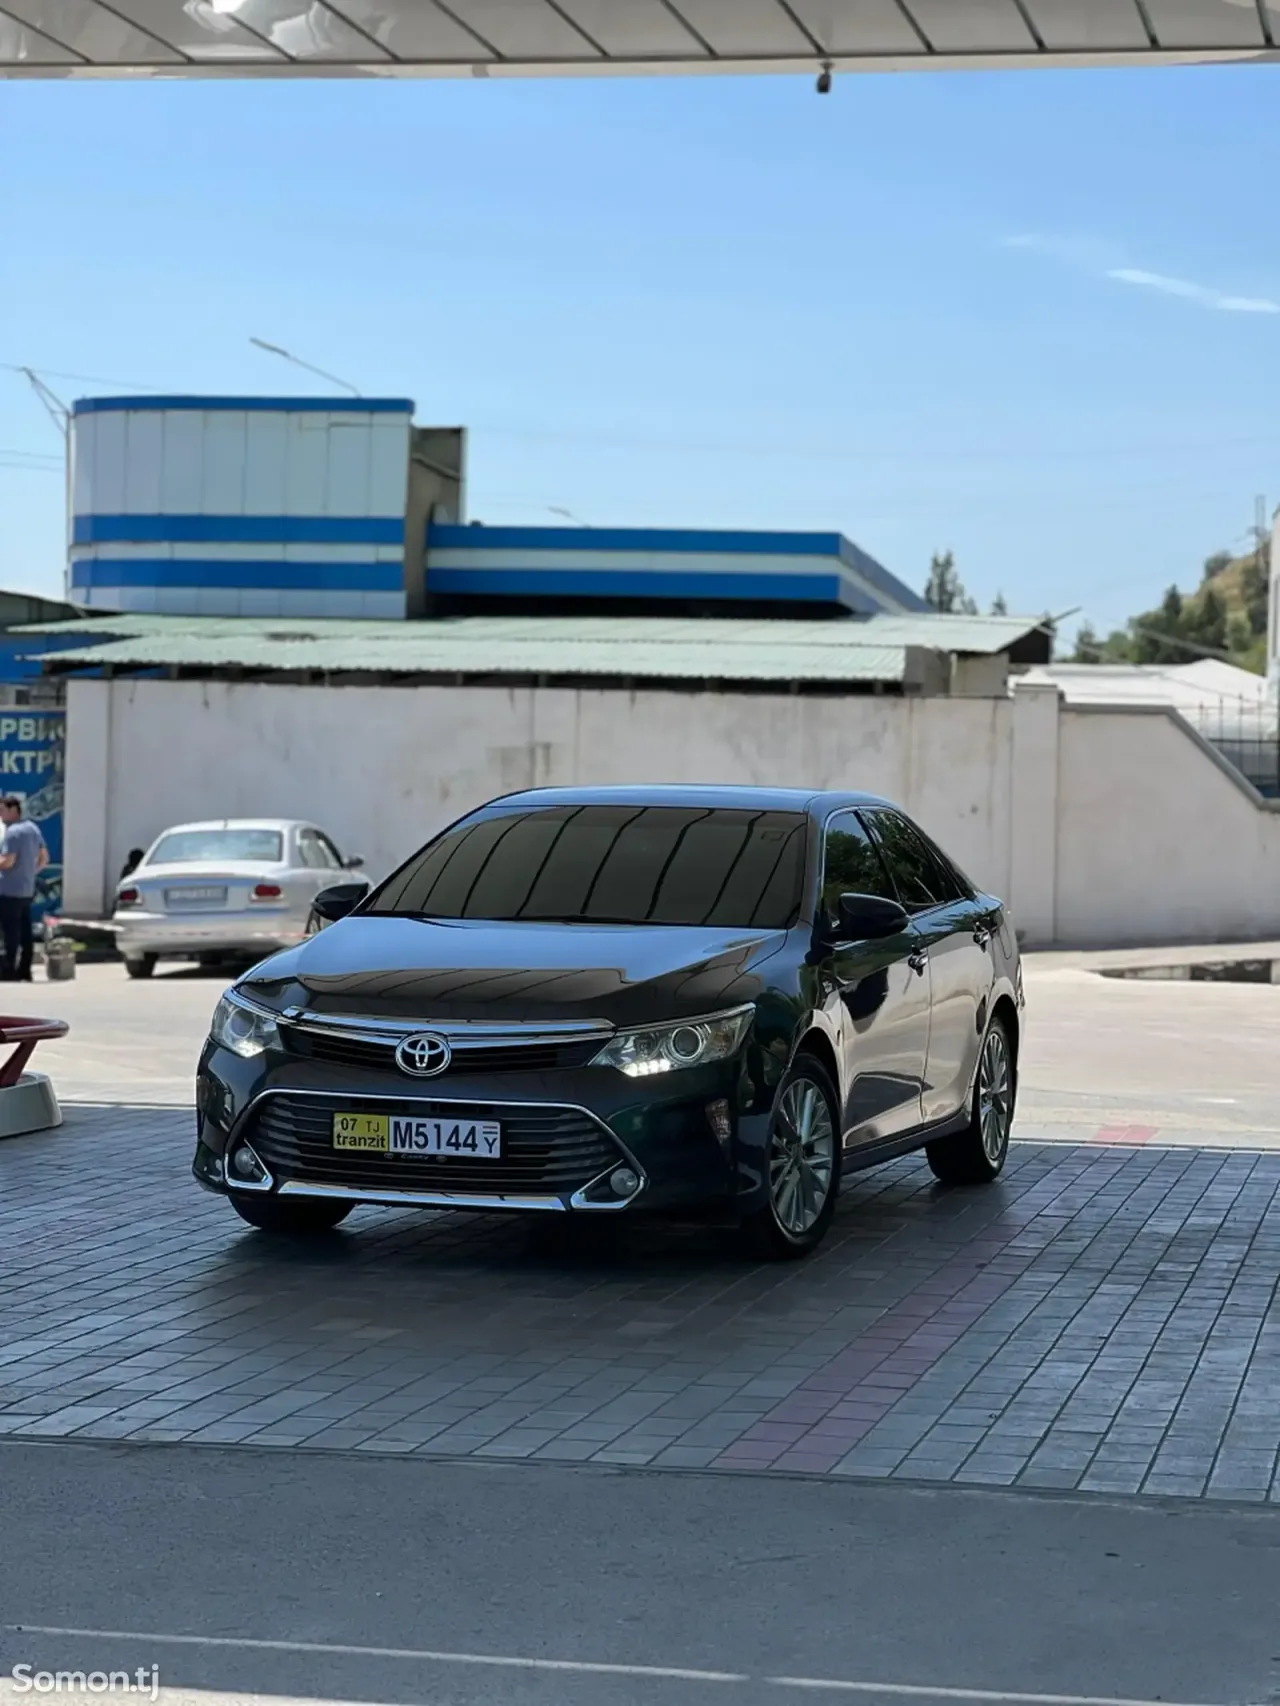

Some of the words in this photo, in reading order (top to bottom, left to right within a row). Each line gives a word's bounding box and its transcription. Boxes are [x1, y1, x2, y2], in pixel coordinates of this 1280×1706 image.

[340, 1117, 358, 1131] 07
[366, 1120, 380, 1133] TJ
[336, 1133, 386, 1149] tranzit
[393, 1120, 478, 1152] M5144
[483, 1136, 498, 1154] Y
